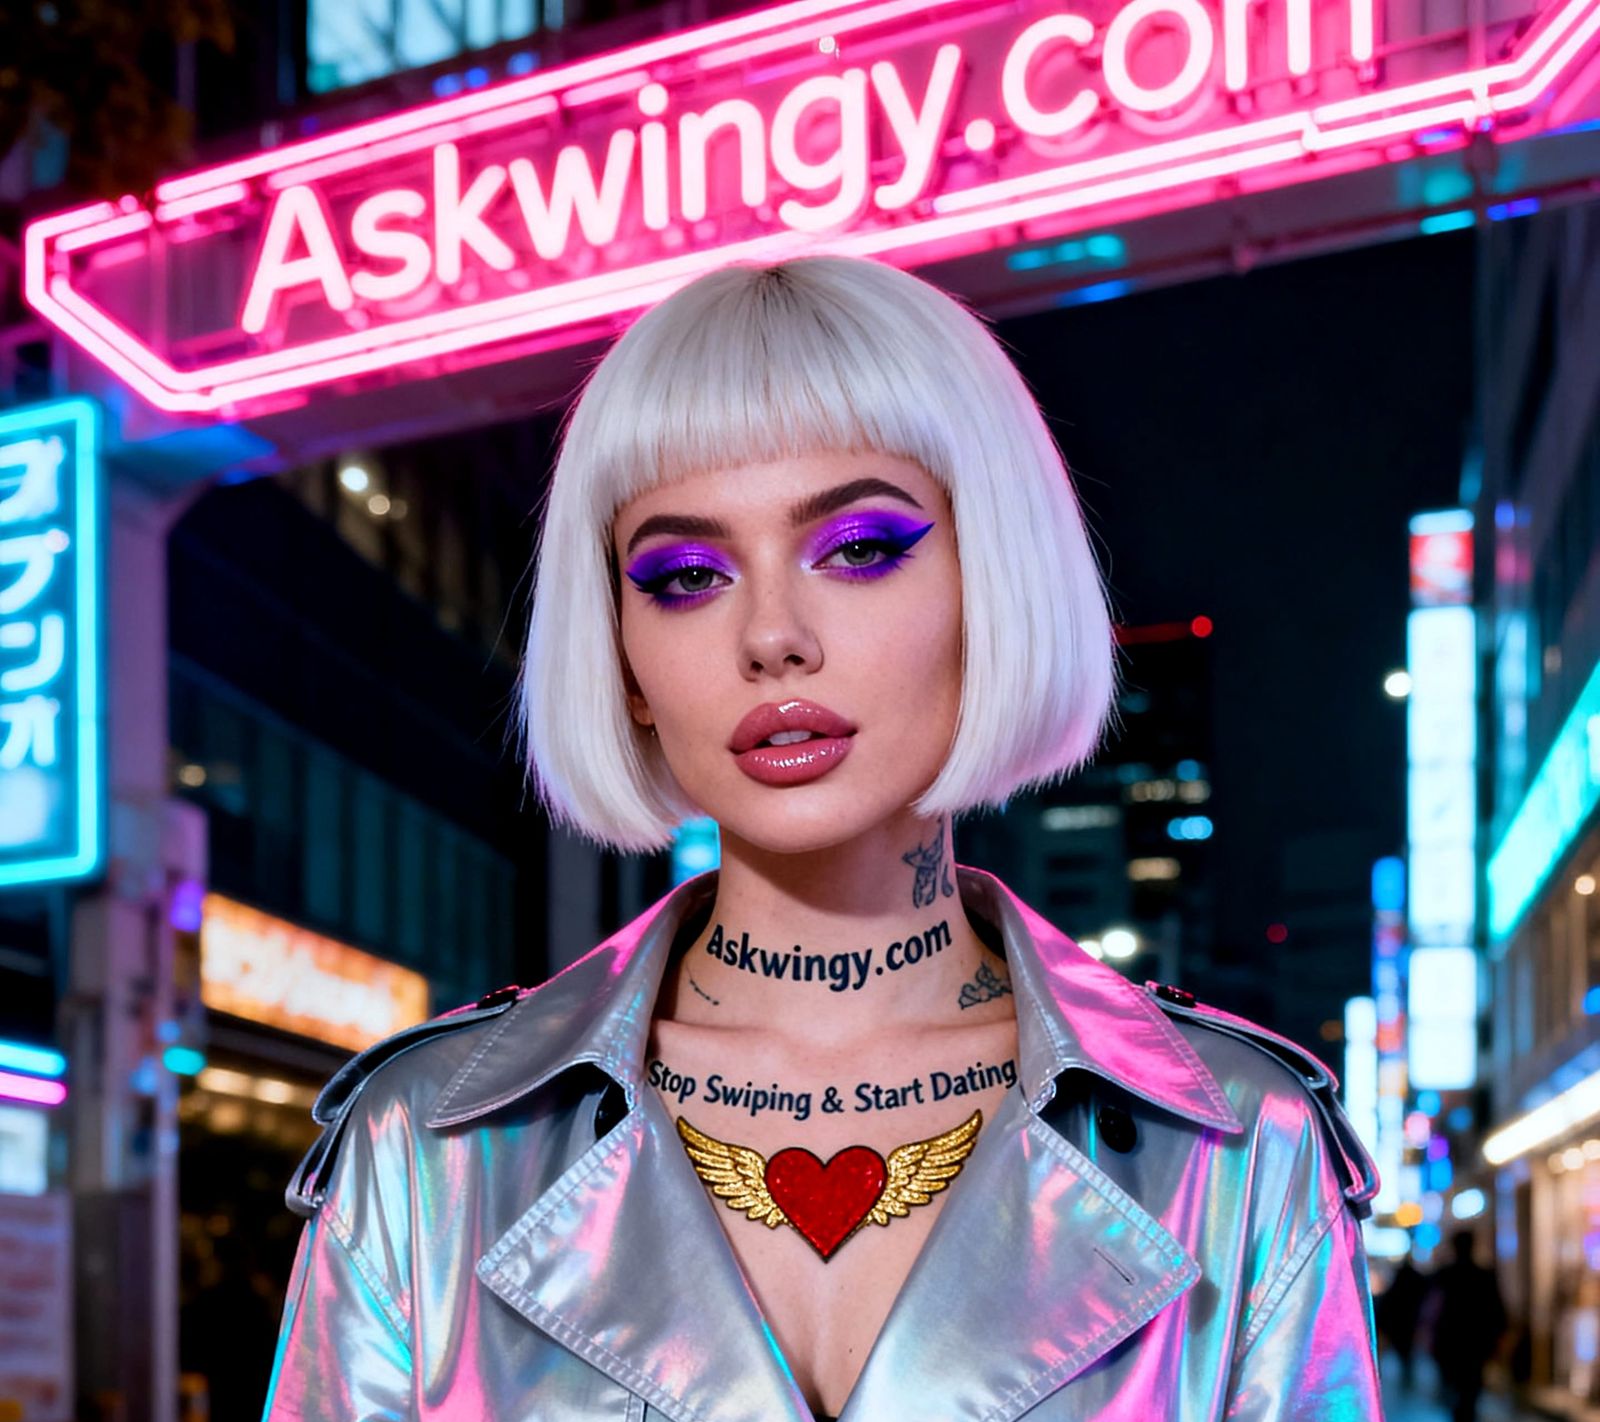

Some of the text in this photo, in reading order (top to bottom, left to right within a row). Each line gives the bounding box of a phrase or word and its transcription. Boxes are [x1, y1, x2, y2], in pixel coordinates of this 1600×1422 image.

[242, 0, 1374, 334] Askwingy.com
[706, 920, 952, 992] Askwingy.com
[648, 1059, 1017, 1121] Stop Swiping & Start Dating
